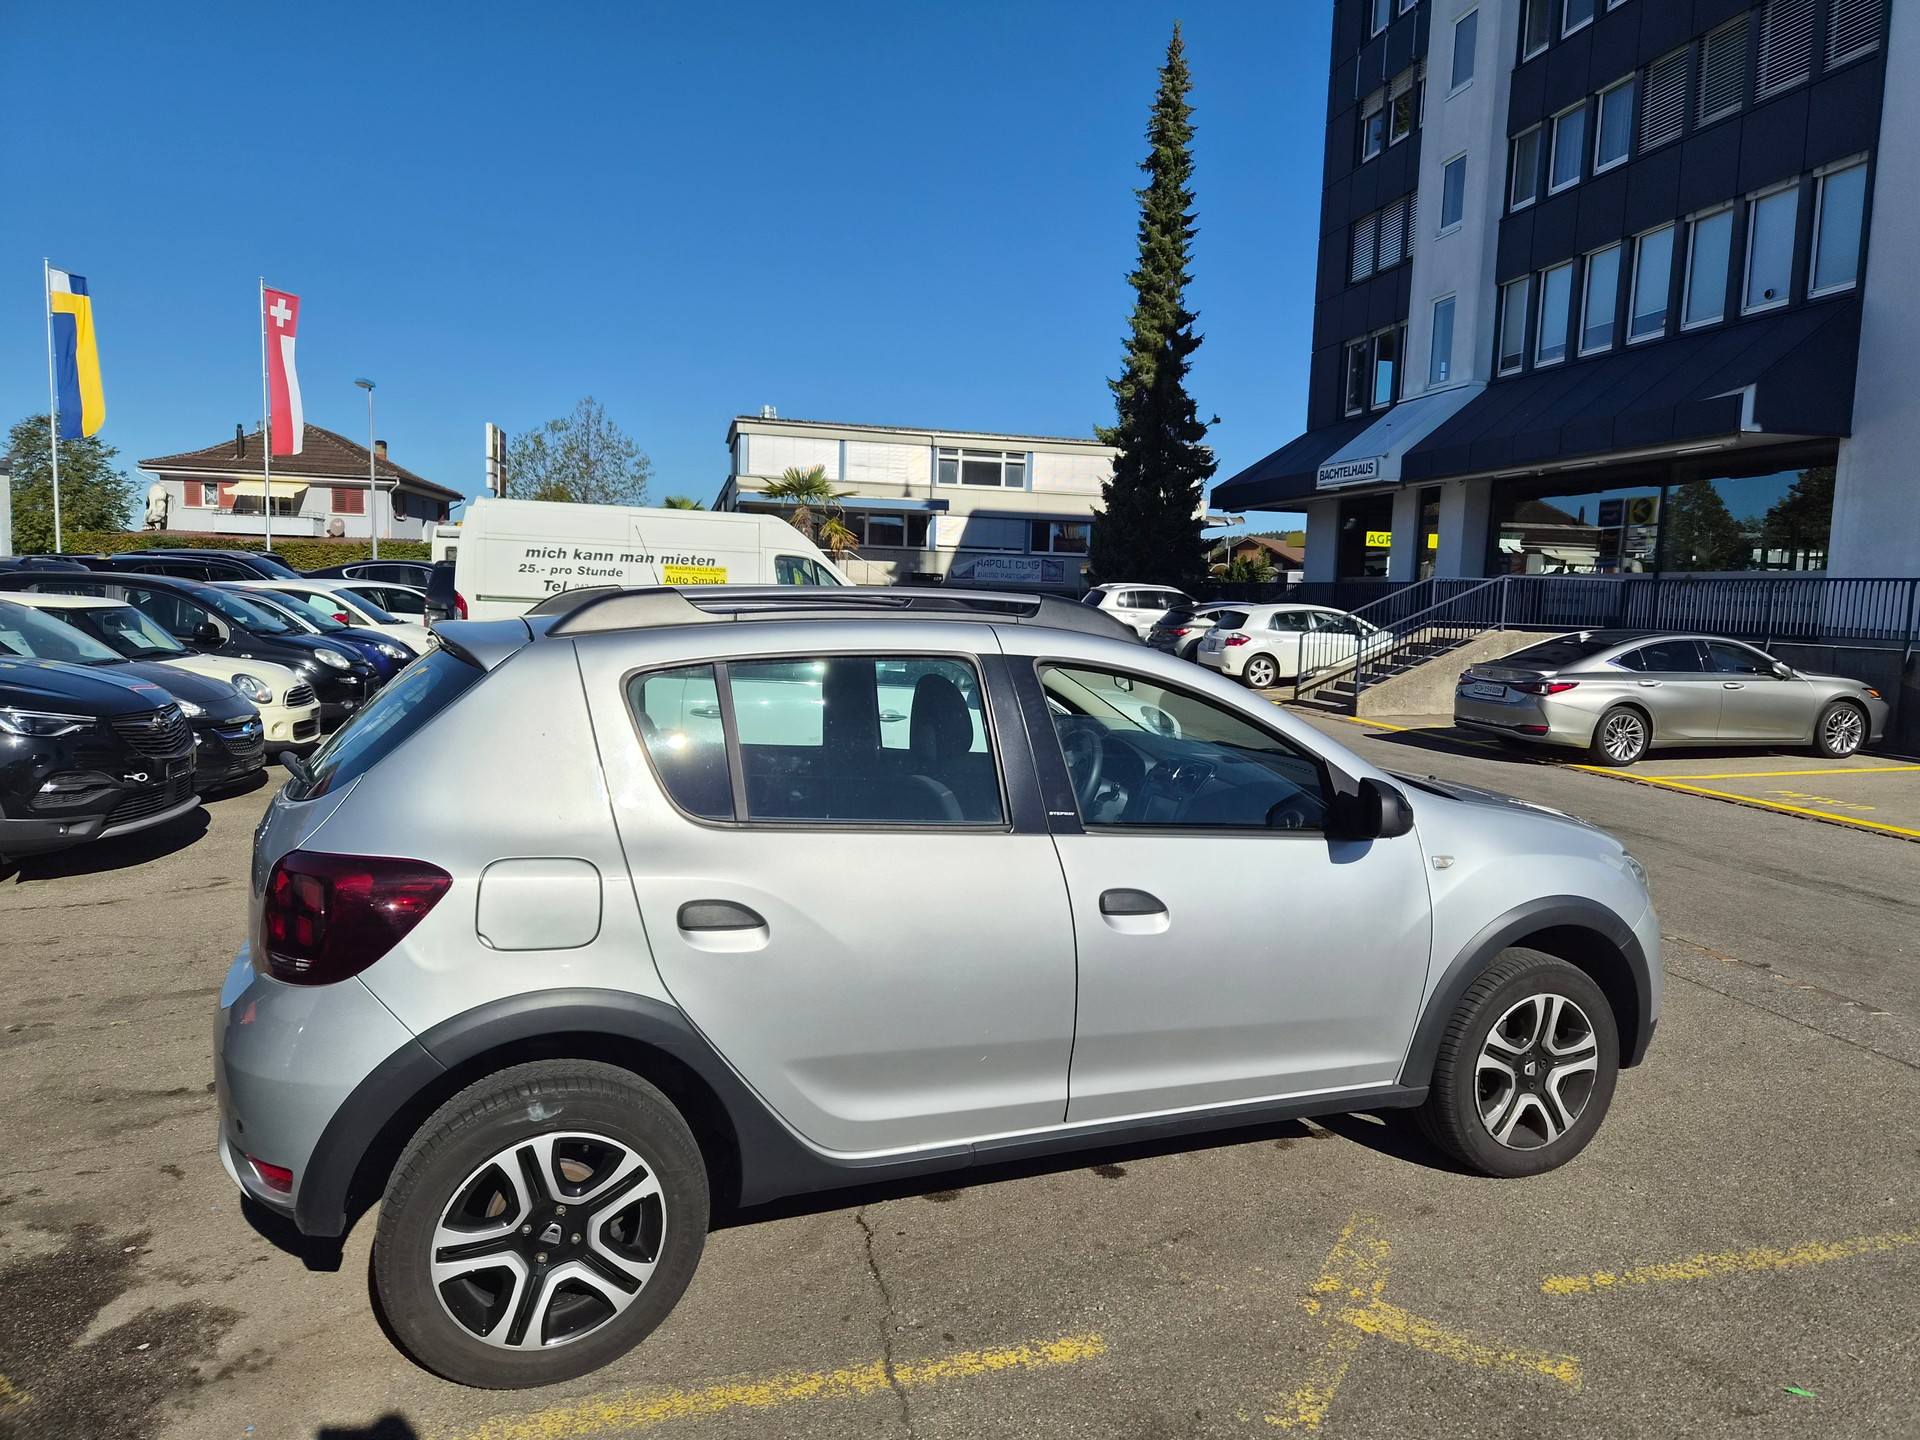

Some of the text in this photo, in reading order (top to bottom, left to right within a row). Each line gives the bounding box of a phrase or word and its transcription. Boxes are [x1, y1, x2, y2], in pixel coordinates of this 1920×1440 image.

[1320, 462, 1374, 481] BACHTELHAUS
[525, 547, 716, 567] mich kann man mieten
[976, 559, 1012, 569] NAPOLI
[518, 563, 623, 577] 25.- pro Stunde
[665, 575, 726, 585] Auto Smaka
